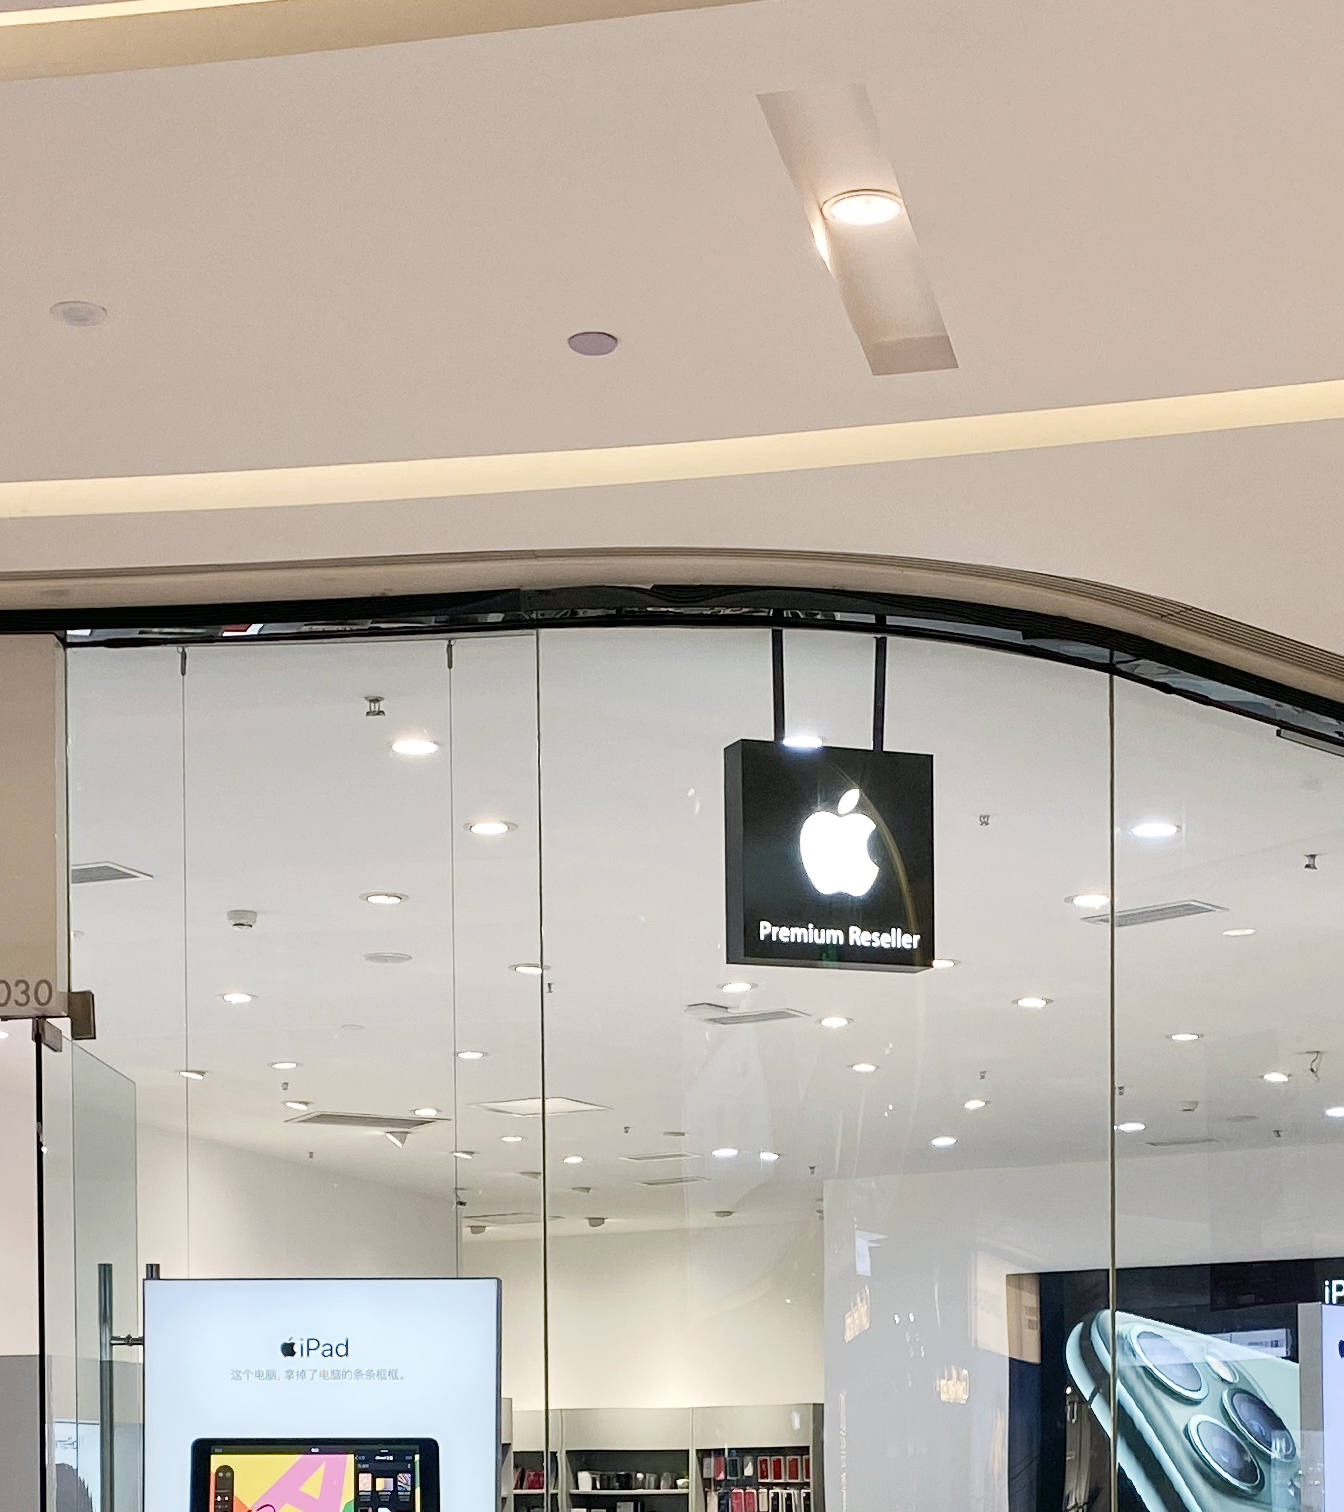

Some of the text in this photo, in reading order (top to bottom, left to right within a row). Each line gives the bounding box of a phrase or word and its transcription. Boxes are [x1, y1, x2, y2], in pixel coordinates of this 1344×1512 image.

[759, 920, 921, 949] Premium Reseller
[299, 1337, 350, 1358] iPad
